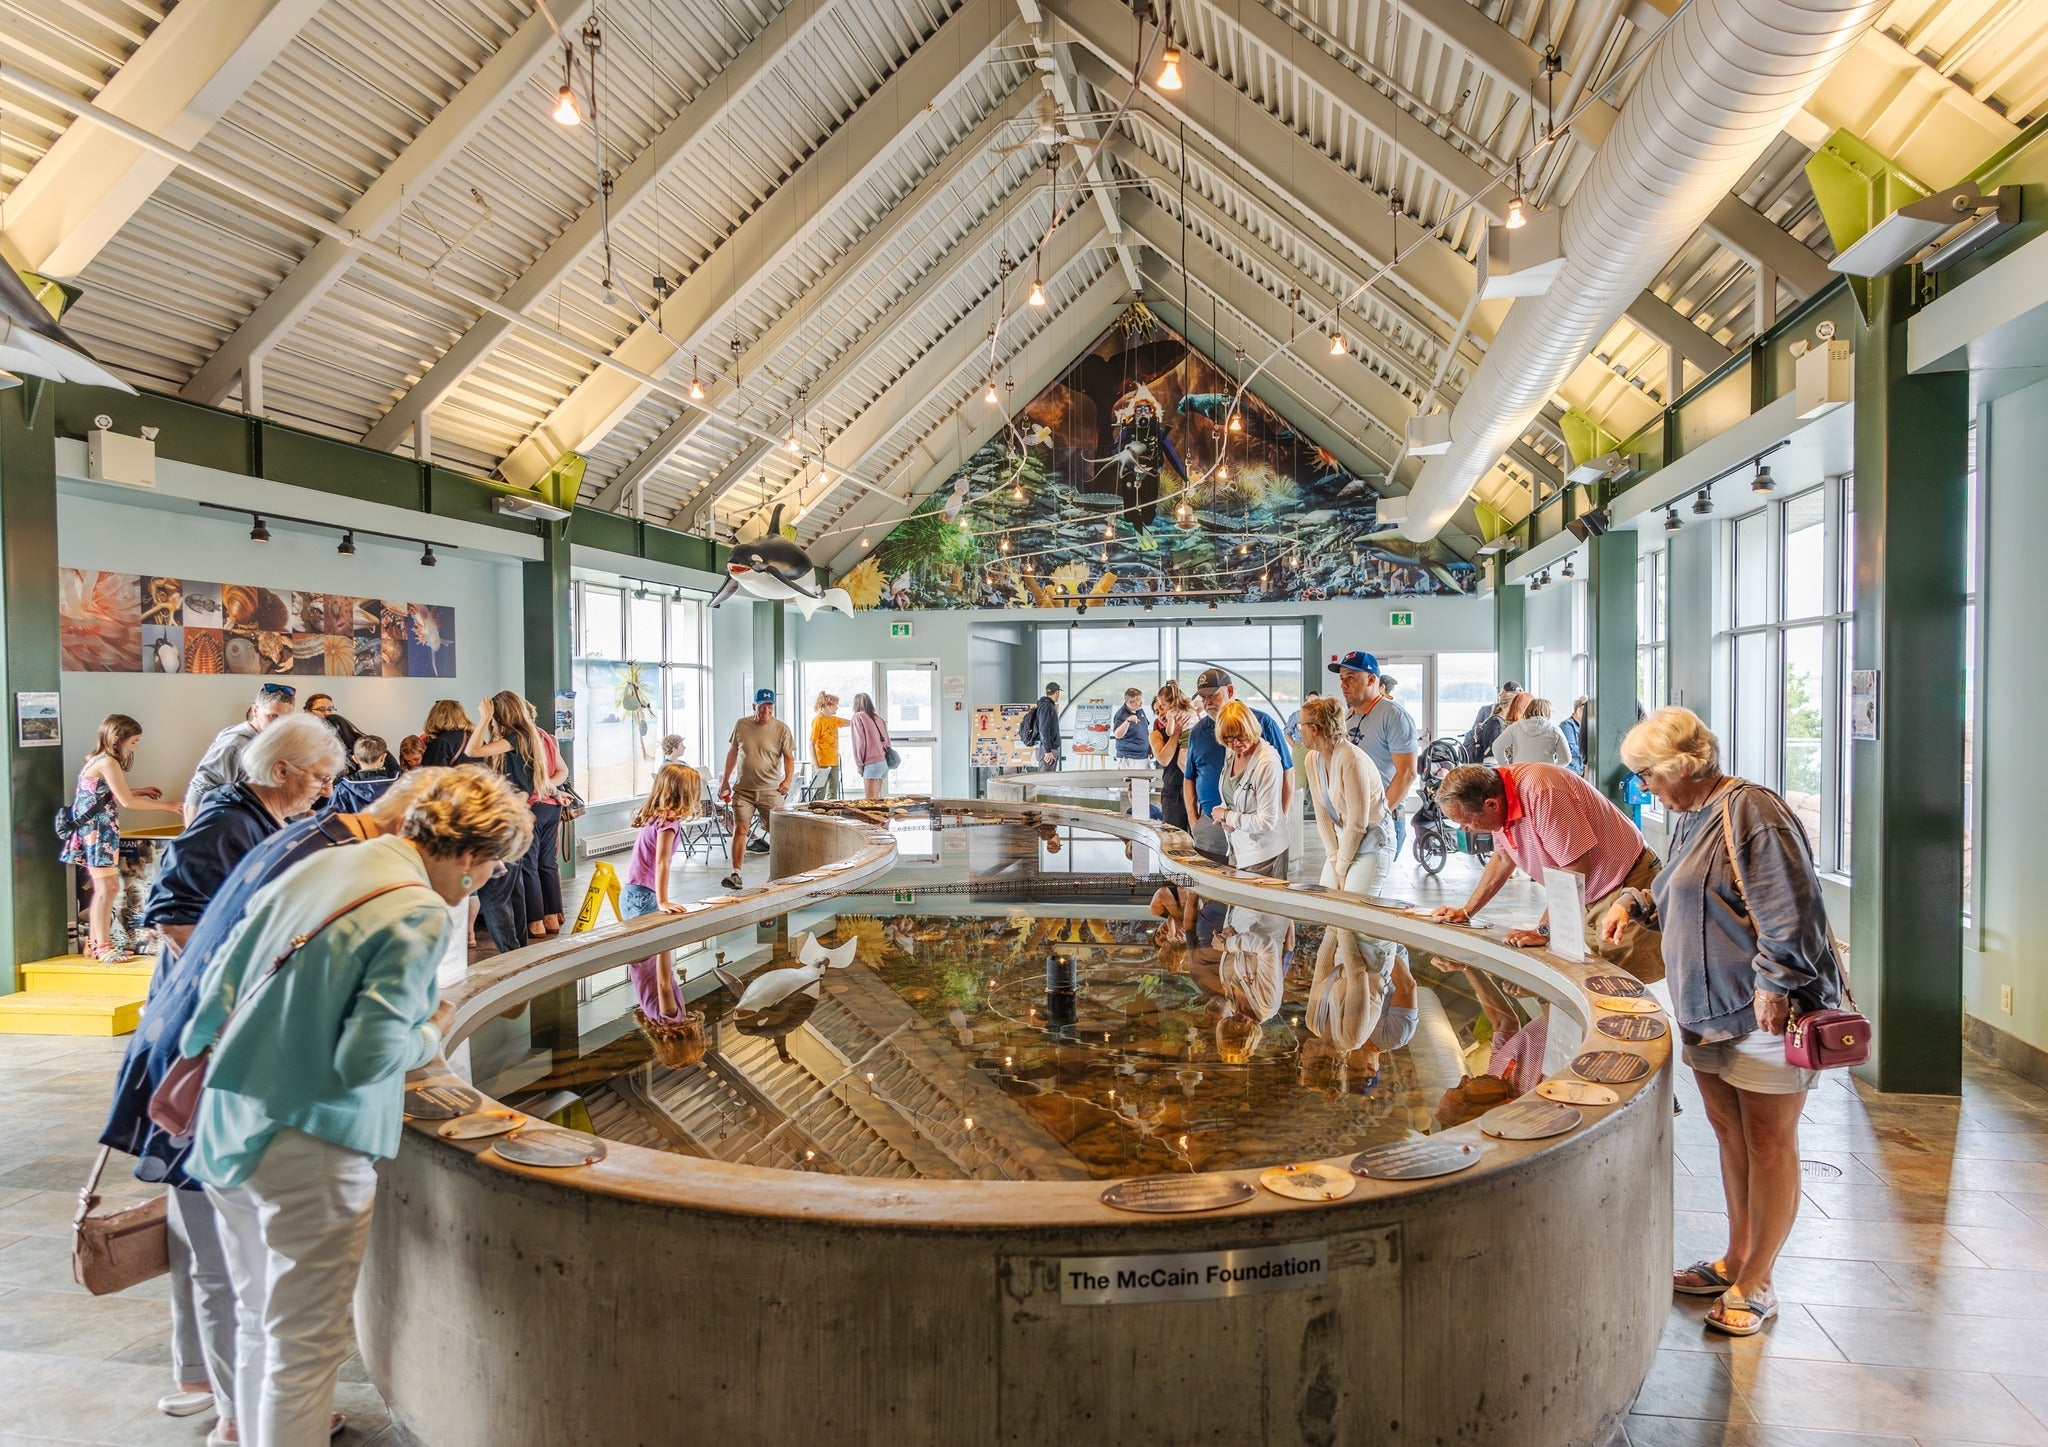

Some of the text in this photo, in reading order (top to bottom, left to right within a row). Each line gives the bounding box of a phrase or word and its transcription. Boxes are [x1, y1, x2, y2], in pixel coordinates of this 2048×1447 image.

[1068, 1256, 1321, 1290] The McCain Foundation
